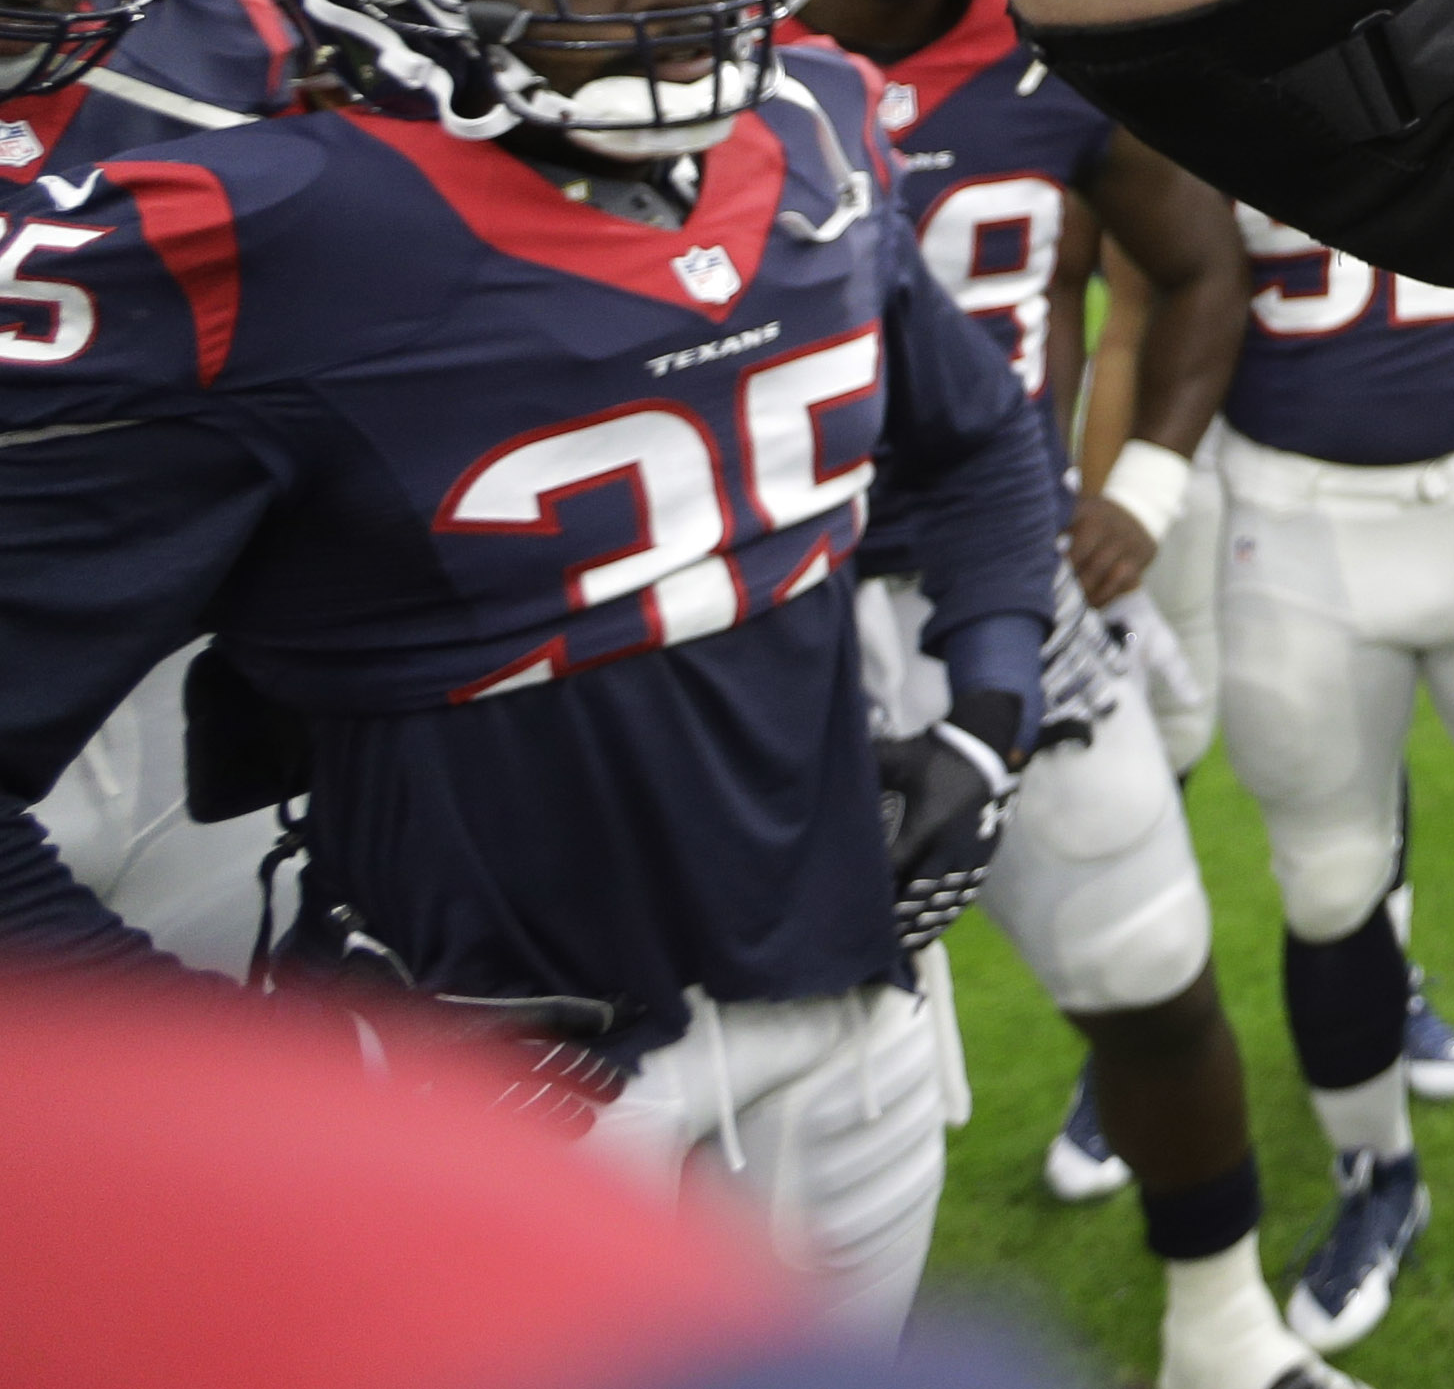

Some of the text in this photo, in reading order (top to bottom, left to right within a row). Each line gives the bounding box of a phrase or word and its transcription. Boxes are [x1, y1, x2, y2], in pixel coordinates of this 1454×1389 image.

[0, 212, 117, 366] 5
[645, 320, 782, 379] TEXANS
[430, 316, 883, 705] 35
